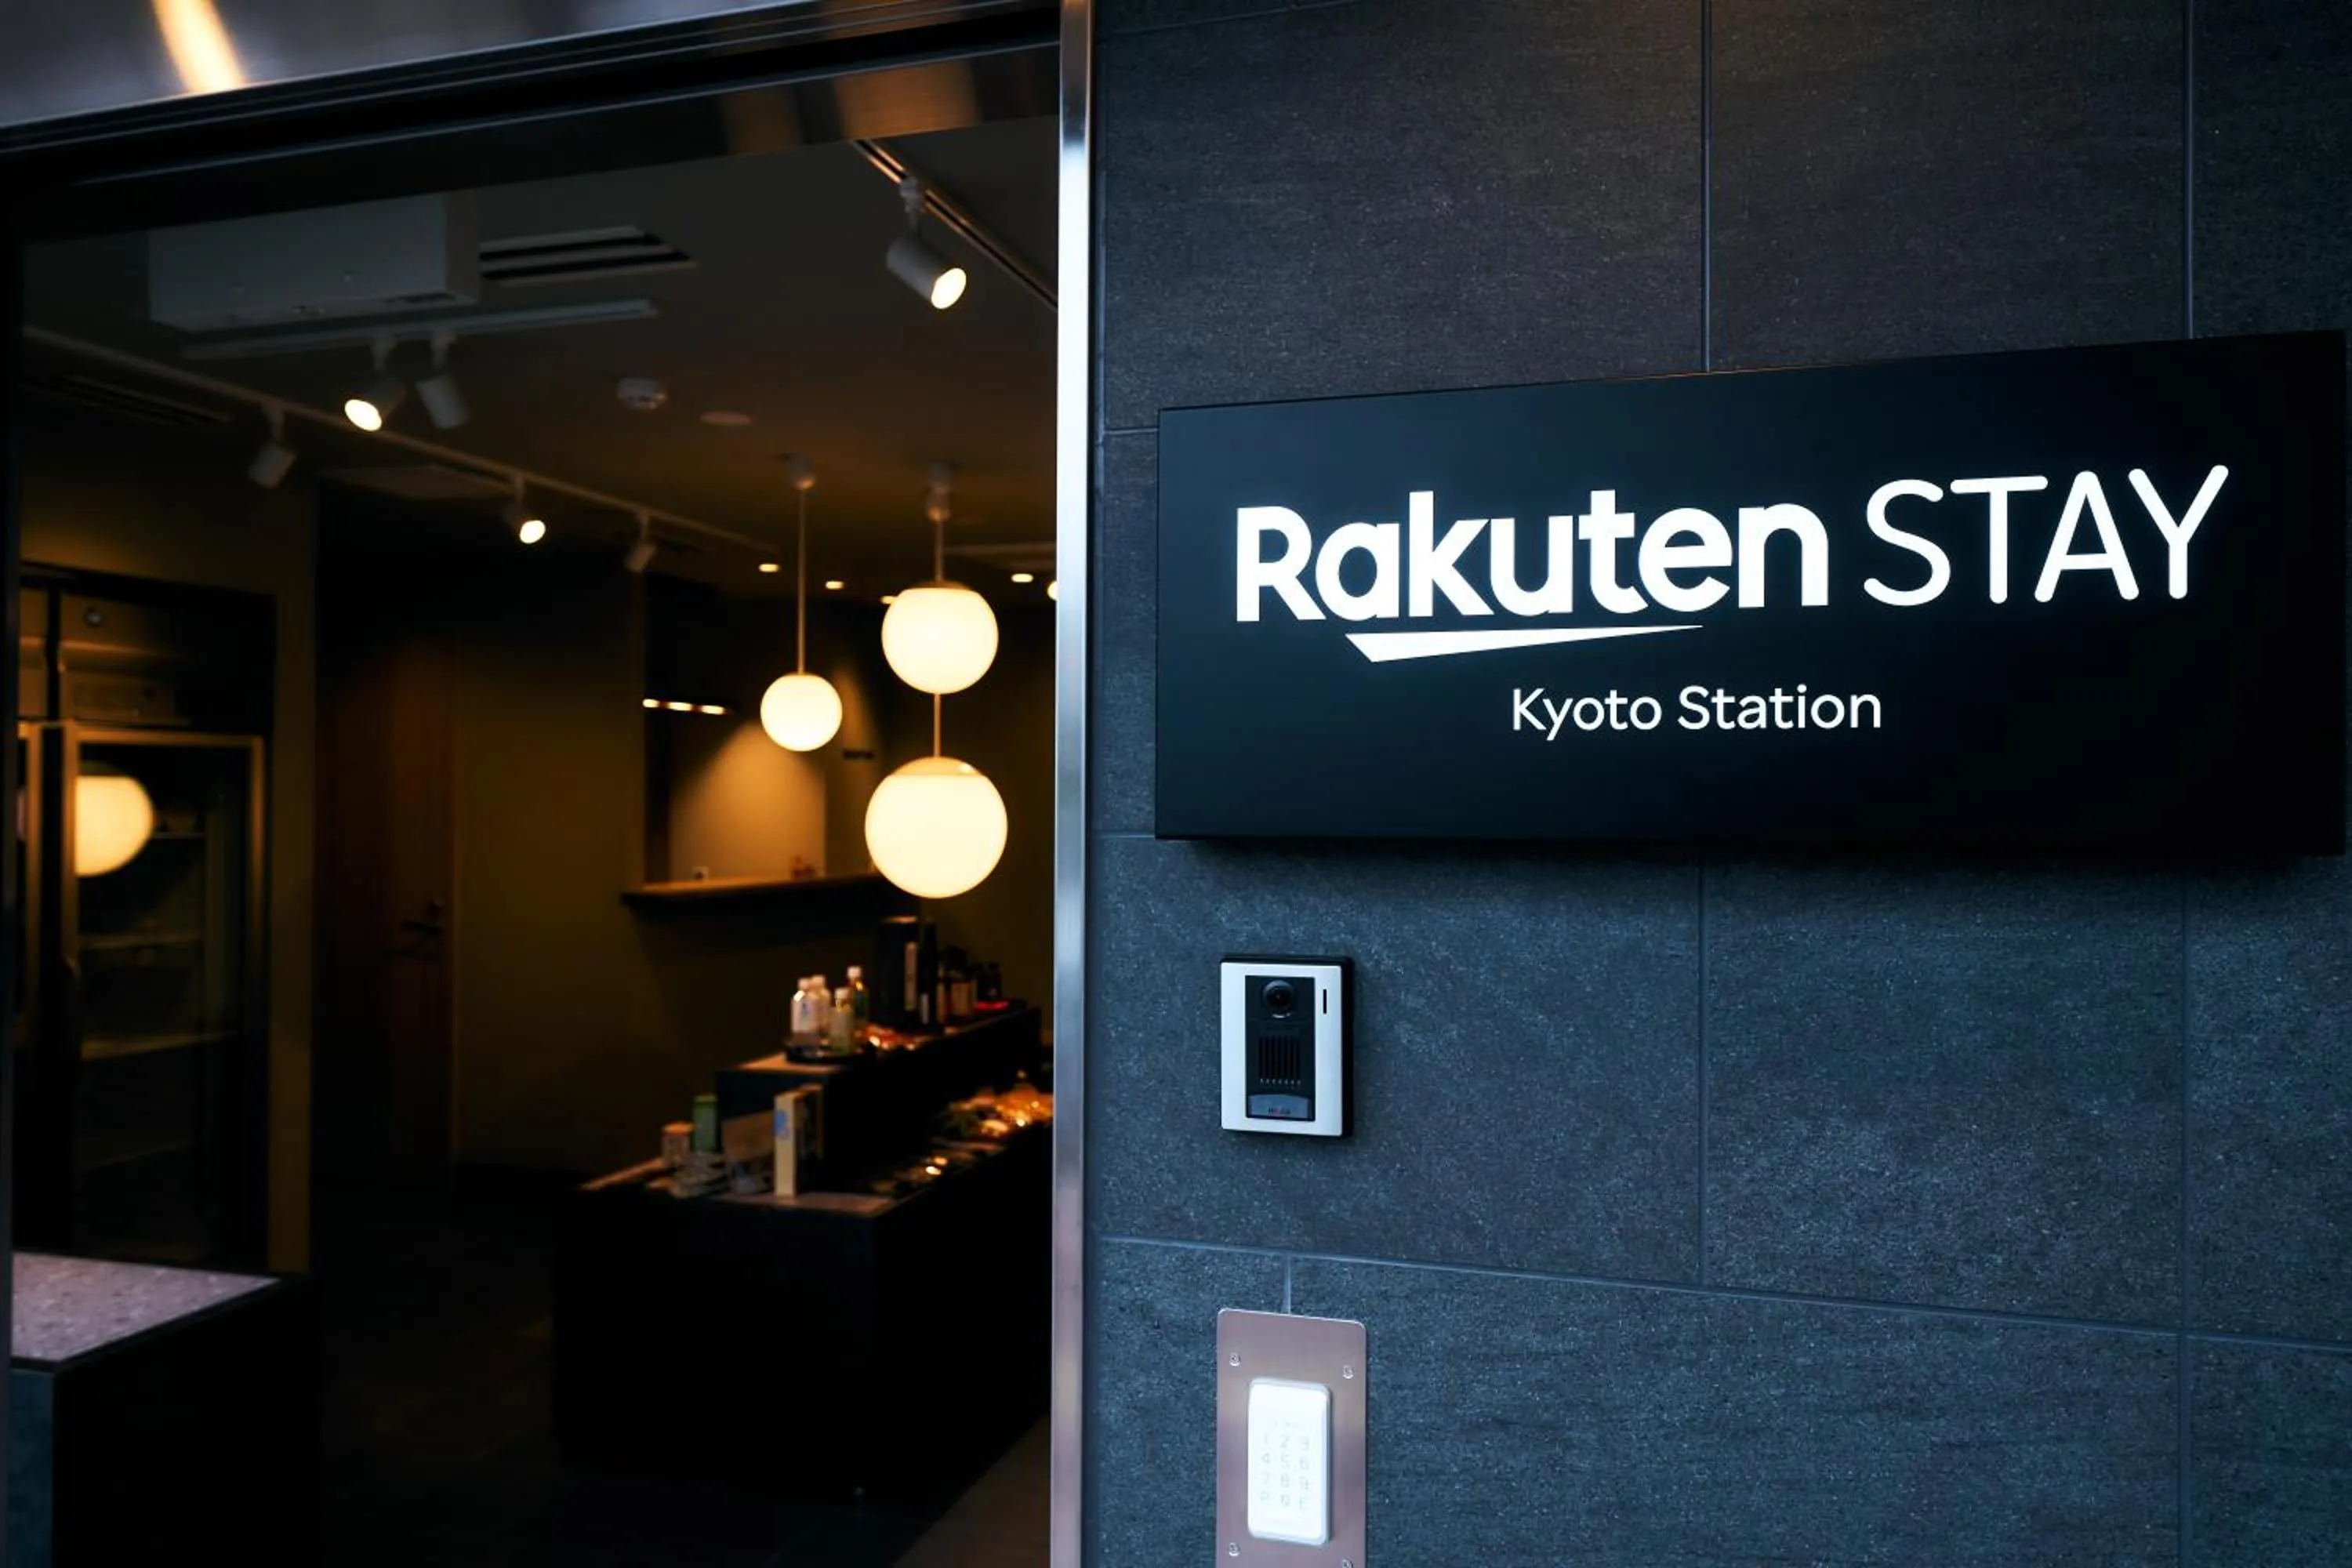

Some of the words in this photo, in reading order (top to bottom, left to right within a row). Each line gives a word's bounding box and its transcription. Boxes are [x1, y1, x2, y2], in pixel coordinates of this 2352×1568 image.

[1236, 489, 1829, 622] Rakuten
[1864, 464, 2229, 607] STAY
[1513, 688, 1663, 742] Kyoto
[1677, 684, 1881, 731] Station
[1280, 1434, 1290, 1449] 2
